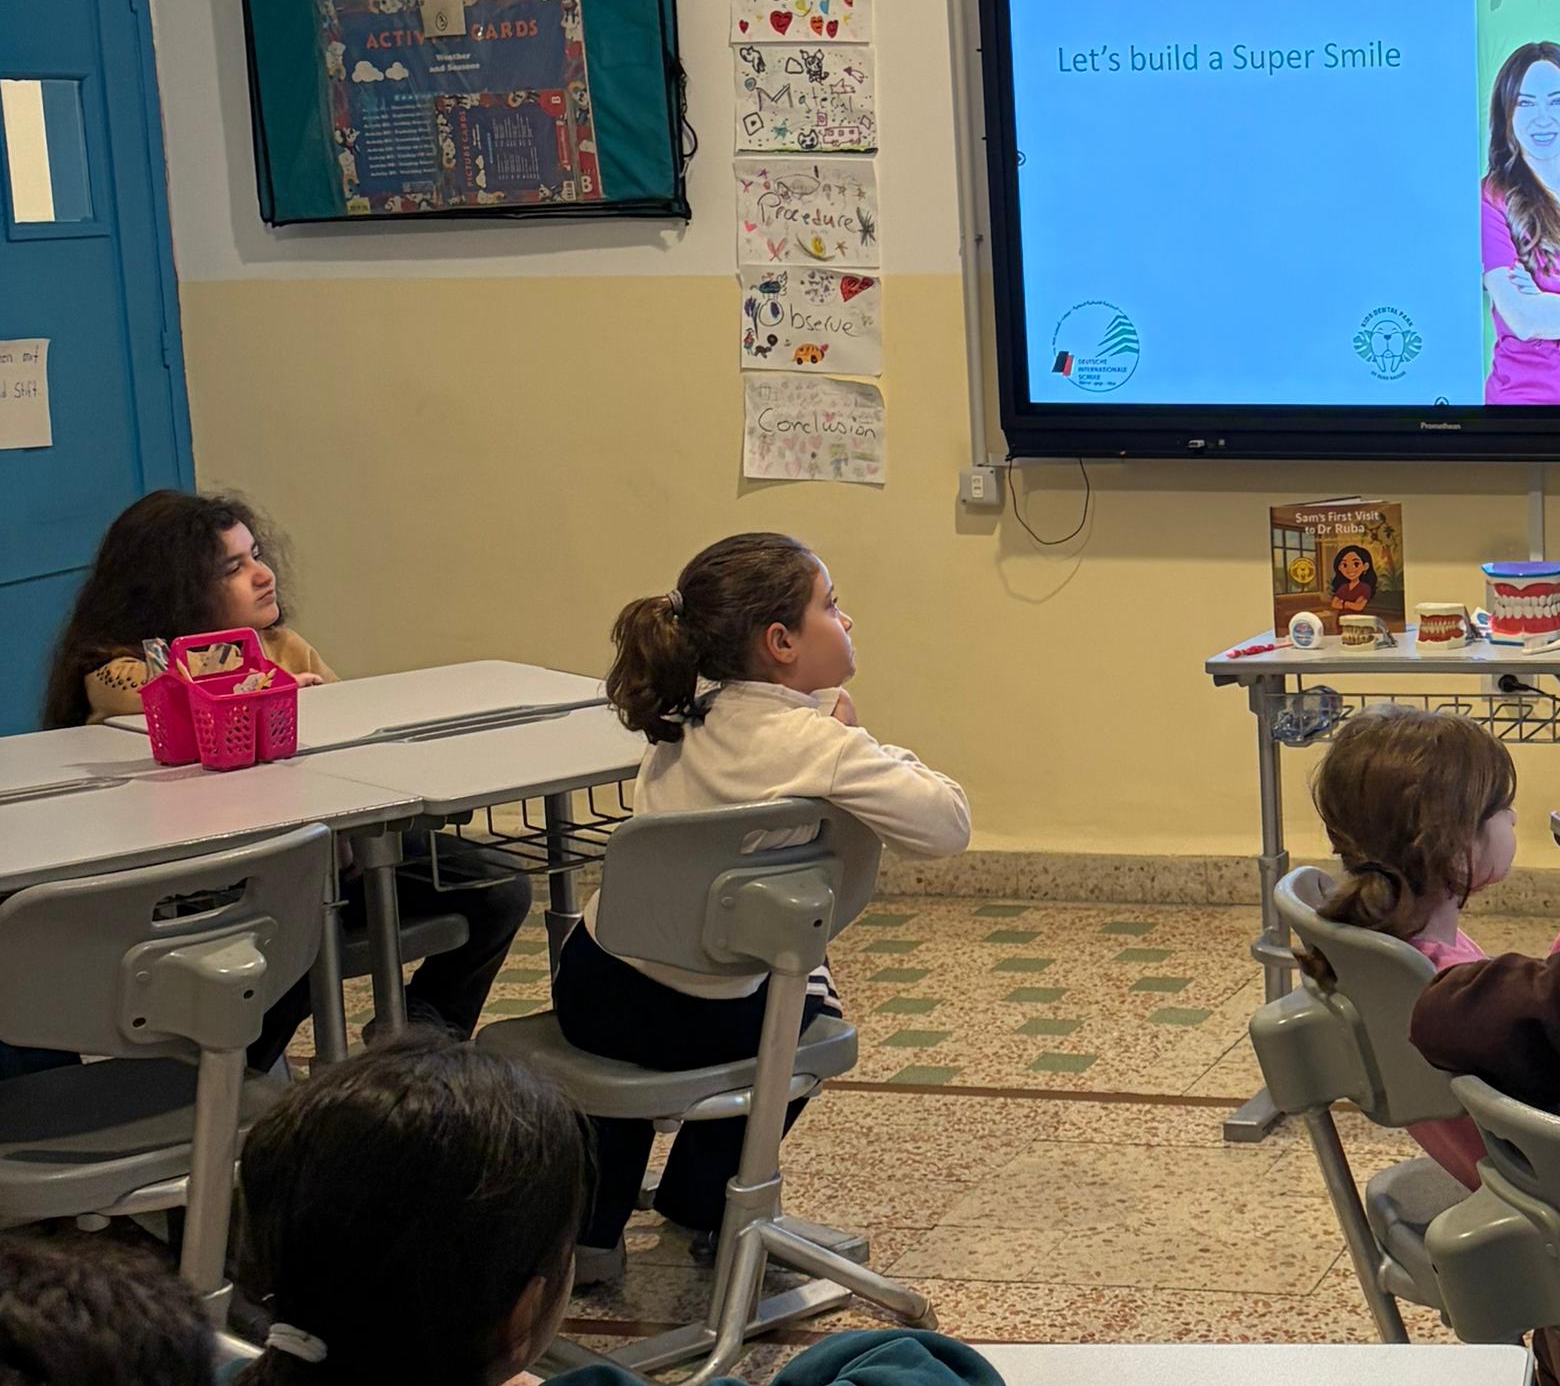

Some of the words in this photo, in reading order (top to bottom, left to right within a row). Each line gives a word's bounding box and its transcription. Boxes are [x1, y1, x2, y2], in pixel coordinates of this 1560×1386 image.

[470, 20, 539, 43] CARDS
[1130, 44, 1199, 72] build
[1208, 50, 1223, 70] a
[1232, 44, 1315, 76] Super
[1323, 41, 1402, 69] Smile
[581, 175, 593, 193] B
[757, 191, 857, 233] Procedure
[758, 298, 860, 337] Observe
[758, 407, 877, 438] Conclusion
[1305, 526, 1316, 534] to
[1317, 524, 1332, 534] Dr
[1335, 523, 1366, 534] Ruba
[1328, 511, 1352, 522] First
[1355, 510, 1380, 521] Visit
